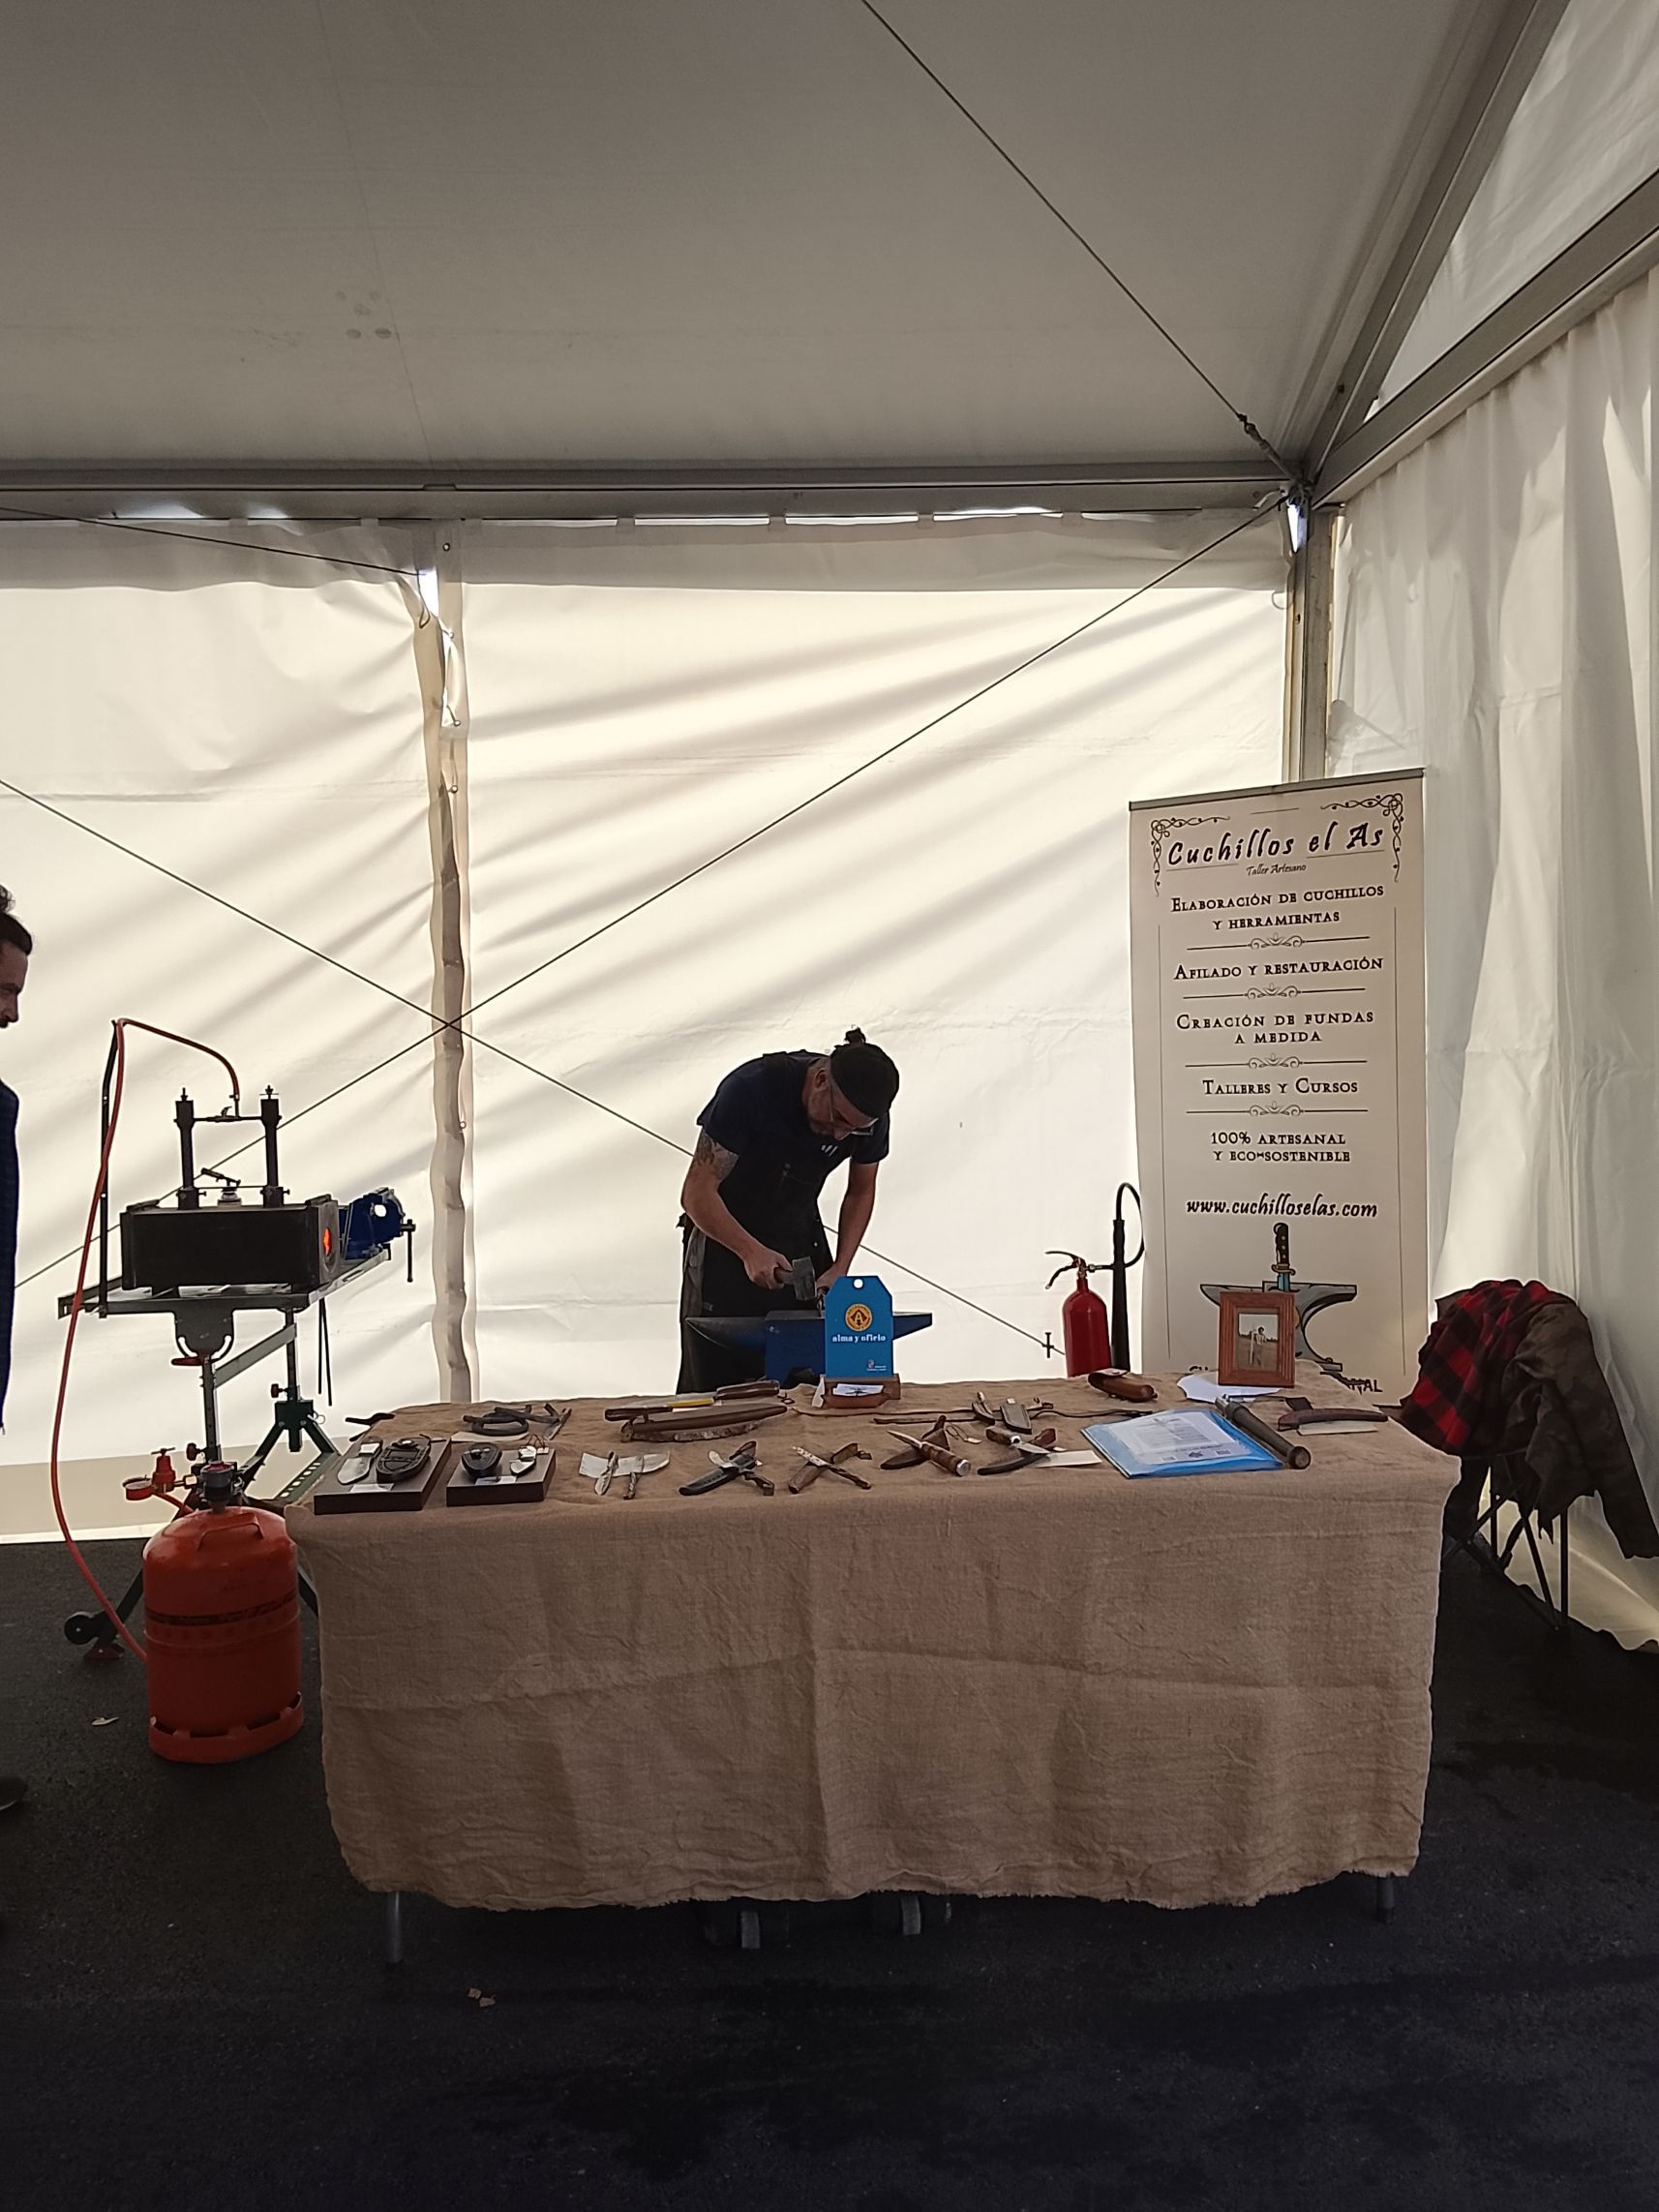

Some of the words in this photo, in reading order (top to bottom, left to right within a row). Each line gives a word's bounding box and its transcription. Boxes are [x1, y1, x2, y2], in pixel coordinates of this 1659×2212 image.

[1167, 828, 1294, 865] Cuchillos
[1309, 821, 1338, 852] el
[1345, 822, 1384, 850] As
[1246, 864, 1269, 876] Taller
[1170, 893, 1272, 912] ELABORACIÓN
[1277, 893, 1298, 904] DE
[1303, 885, 1385, 902] CUCHILLOS
[1212, 920, 1222, 930] Y
[1228, 911, 1340, 929] HERRAMIENTAS
[1173, 964, 1242, 981] AFILADO
[1248, 965, 1258, 976] Y
[1264, 956, 1384, 975] RESTAURACIÓN
[1176, 1014, 1265, 1030] CREACIÓN
[1274, 1015, 1295, 1026] DE
[1304, 1011, 1374, 1025] FUNDAS
[1234, 1033, 1246, 1045] A
[1254, 1031, 1323, 1044] MEDIDA
[1202, 1079, 1271, 1095] TALLERES
[1277, 1083, 1288, 1094] Y
[1295, 1077, 1358, 1094] CURSOS
[1210, 1131, 1252, 1145] 100%
[1257, 1134, 1346, 1145] ARTESANAL
[1213, 1150, 1222, 1161] Y
[1186, 1192, 1378, 1218] www.cuchilloselas.com
[832, 1334, 854, 1343] alma
[860, 1333, 887, 1343] oficio
